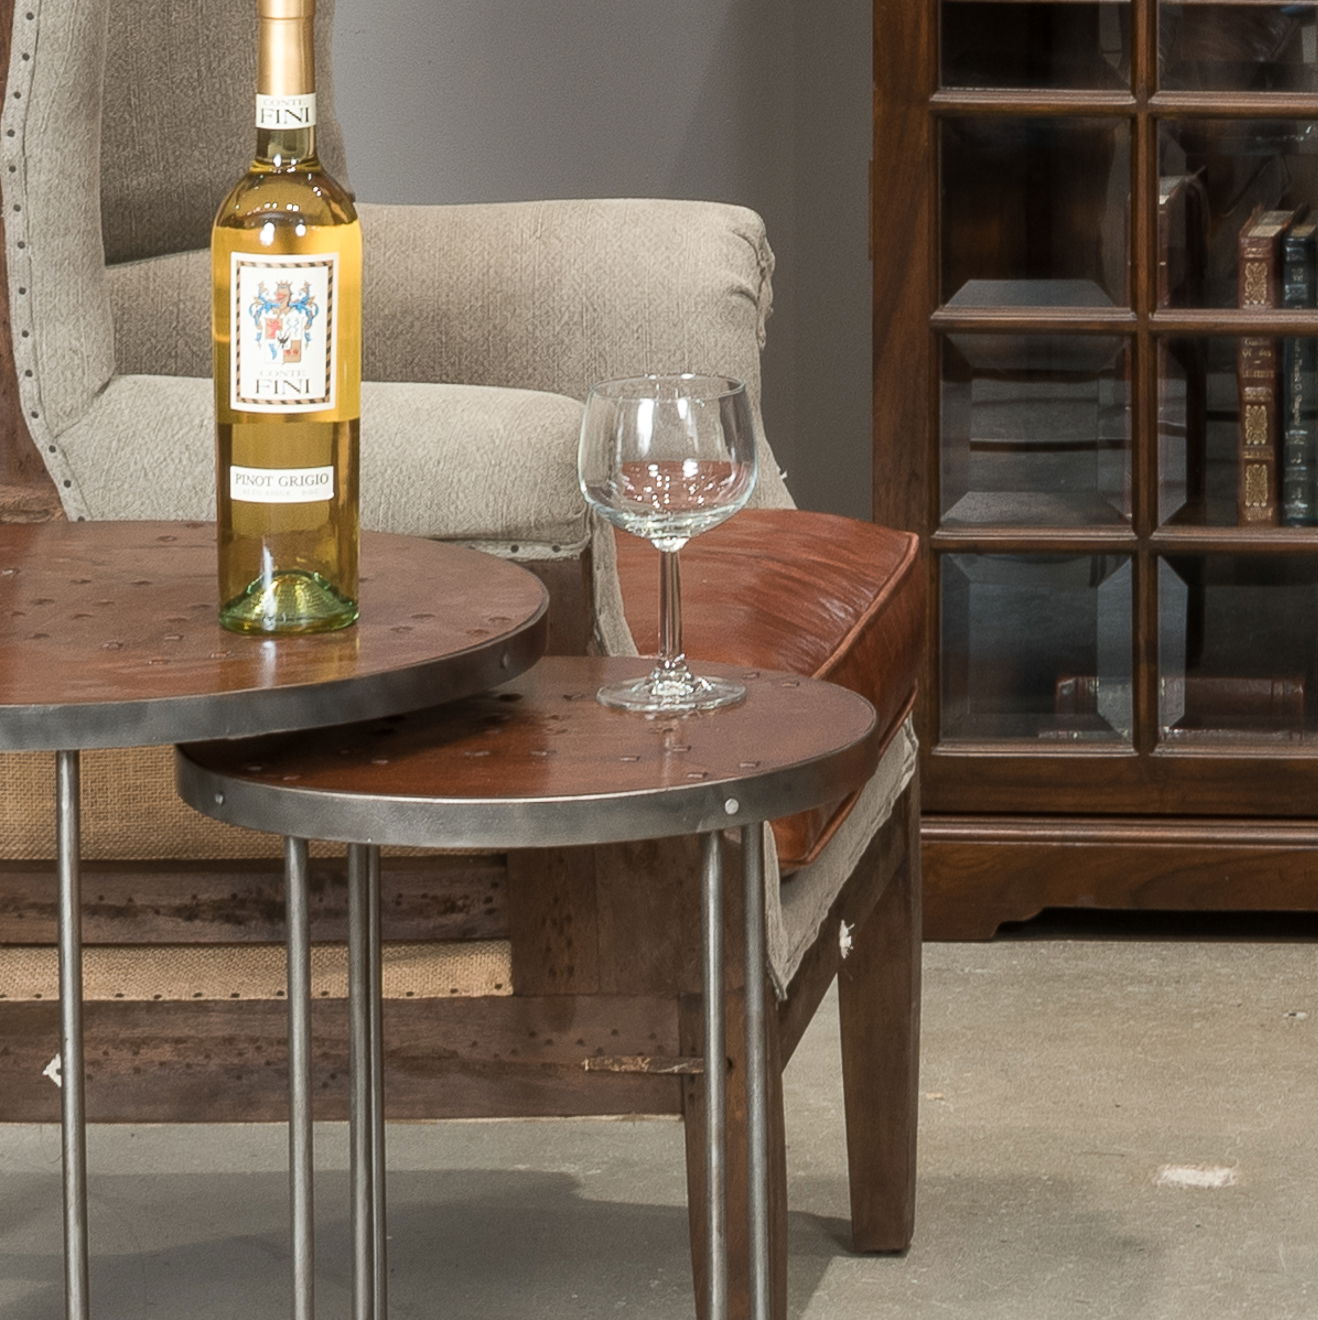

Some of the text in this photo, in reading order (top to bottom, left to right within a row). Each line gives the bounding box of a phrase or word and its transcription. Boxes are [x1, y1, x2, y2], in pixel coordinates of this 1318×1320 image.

[260, 106, 310, 125] FINI
[255, 377, 311, 395] FINI
[234, 472, 330, 488] PINOT GRIGIO
